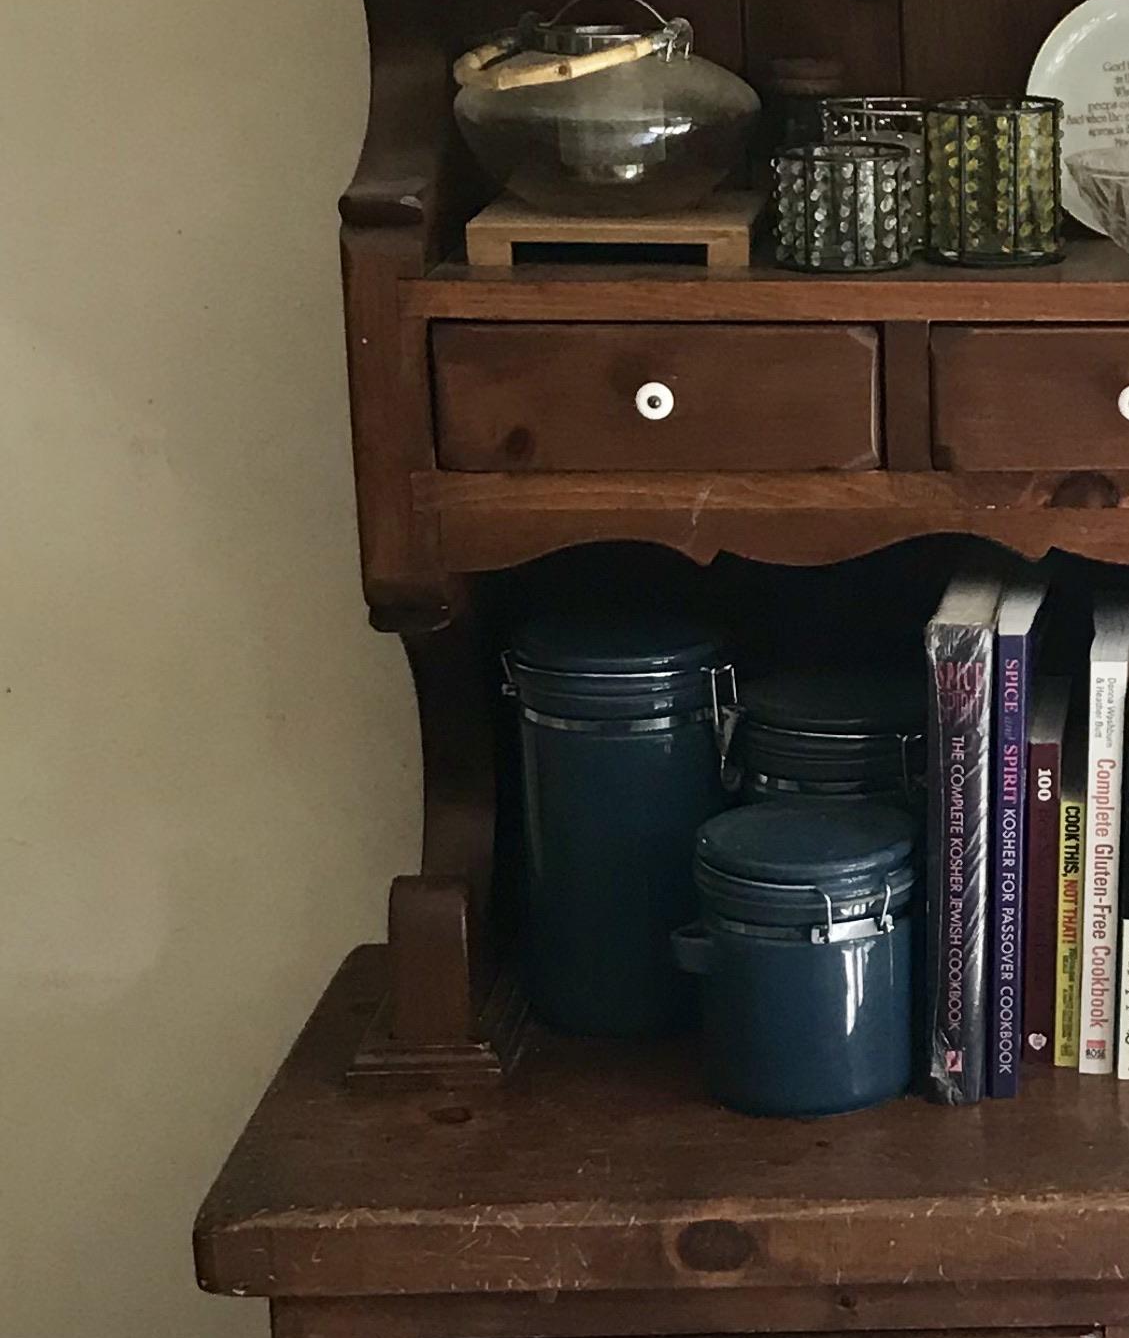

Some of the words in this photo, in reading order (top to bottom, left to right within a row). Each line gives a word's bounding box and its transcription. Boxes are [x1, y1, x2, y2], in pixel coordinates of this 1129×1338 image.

[1004, 659, 1019, 713] SPICE
[1106, 677, 1117, 704] Donna
[951, 736, 965, 761] THE
[1003, 744, 1019, 804] SPIRIT
[950, 764, 965, 834] COMPLETE
[1037, 768, 1052, 802] 100
[1091, 758, 1117, 838] Complete
[1001, 808, 1017, 867] KOSHER
[1064, 806, 1081, 842] COOK
[949, 838, 964, 892] KOSHER
[1001, 872, 1015, 902] FOR
[1061, 843, 1080, 877] THIS,
[1063, 878, 1079, 906] NOT
[1091, 843, 1114, 940] Gluten-Free
[949, 894, 963, 945] JEWISH
[1000, 908, 1015, 980] PASSOVER
[1061, 907, 1078, 944] THAT!
[947, 948, 962, 1031] COOKBOOK
[1089, 945, 1112, 1029] Cookbook
[998, 986, 1014, 1074] COOKBOOK
